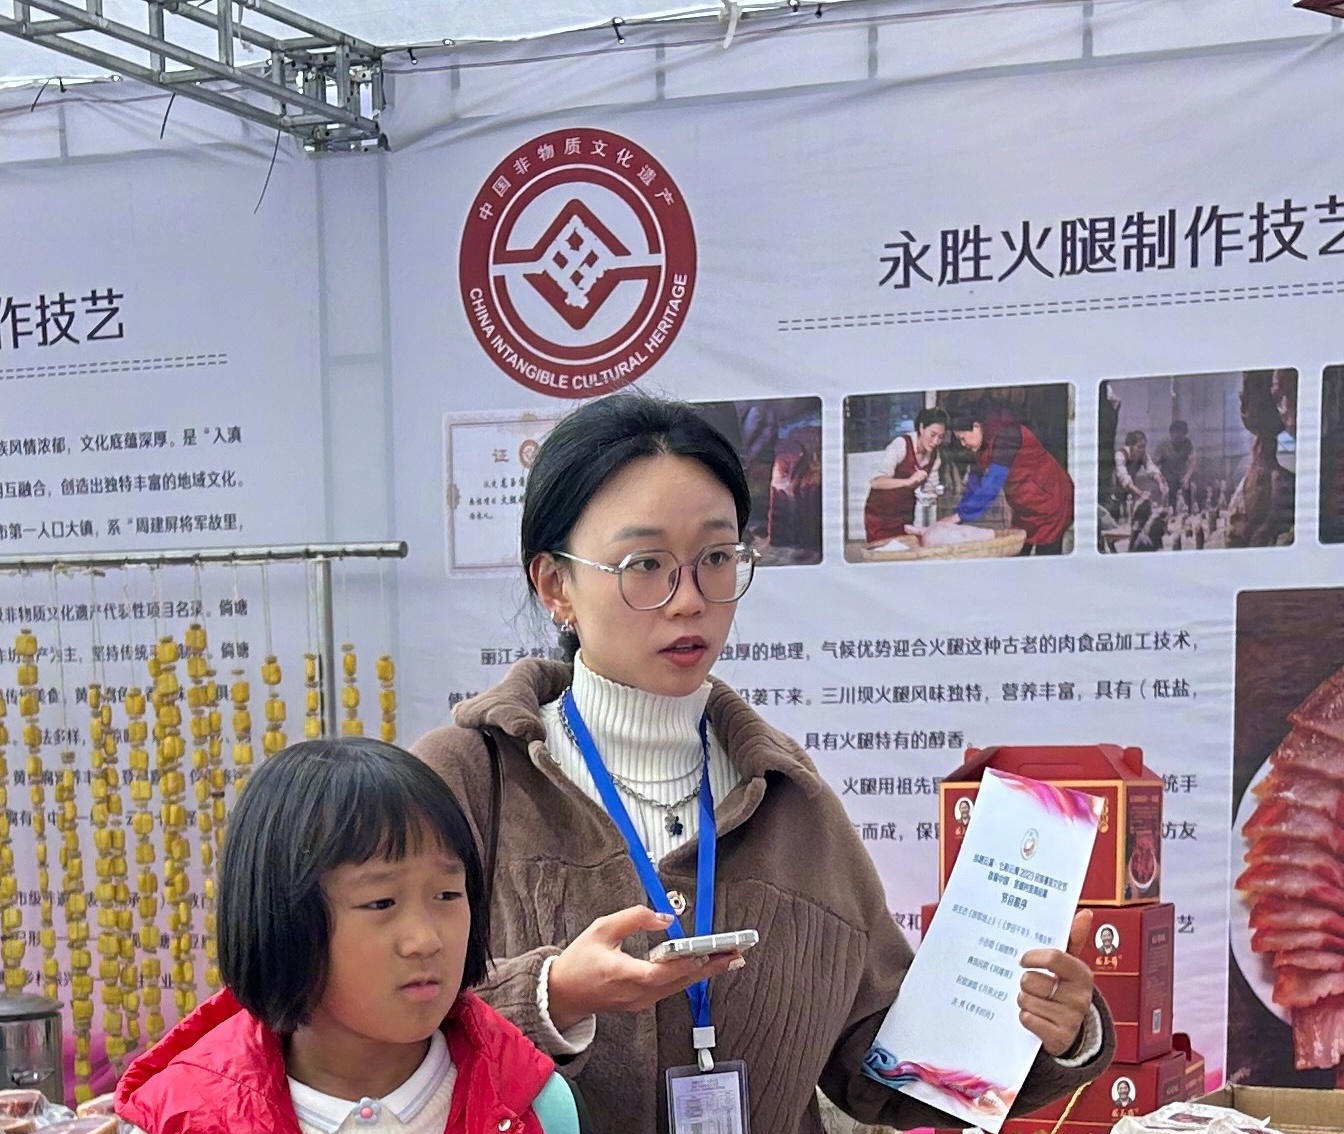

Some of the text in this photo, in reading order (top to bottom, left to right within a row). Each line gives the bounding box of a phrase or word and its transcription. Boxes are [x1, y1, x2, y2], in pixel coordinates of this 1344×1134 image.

[478, 137, 674, 220] 中国非物质文化遗产
[470, 273, 687, 390] CHINA INTANGIBLE CULTURAL HERITAGE
